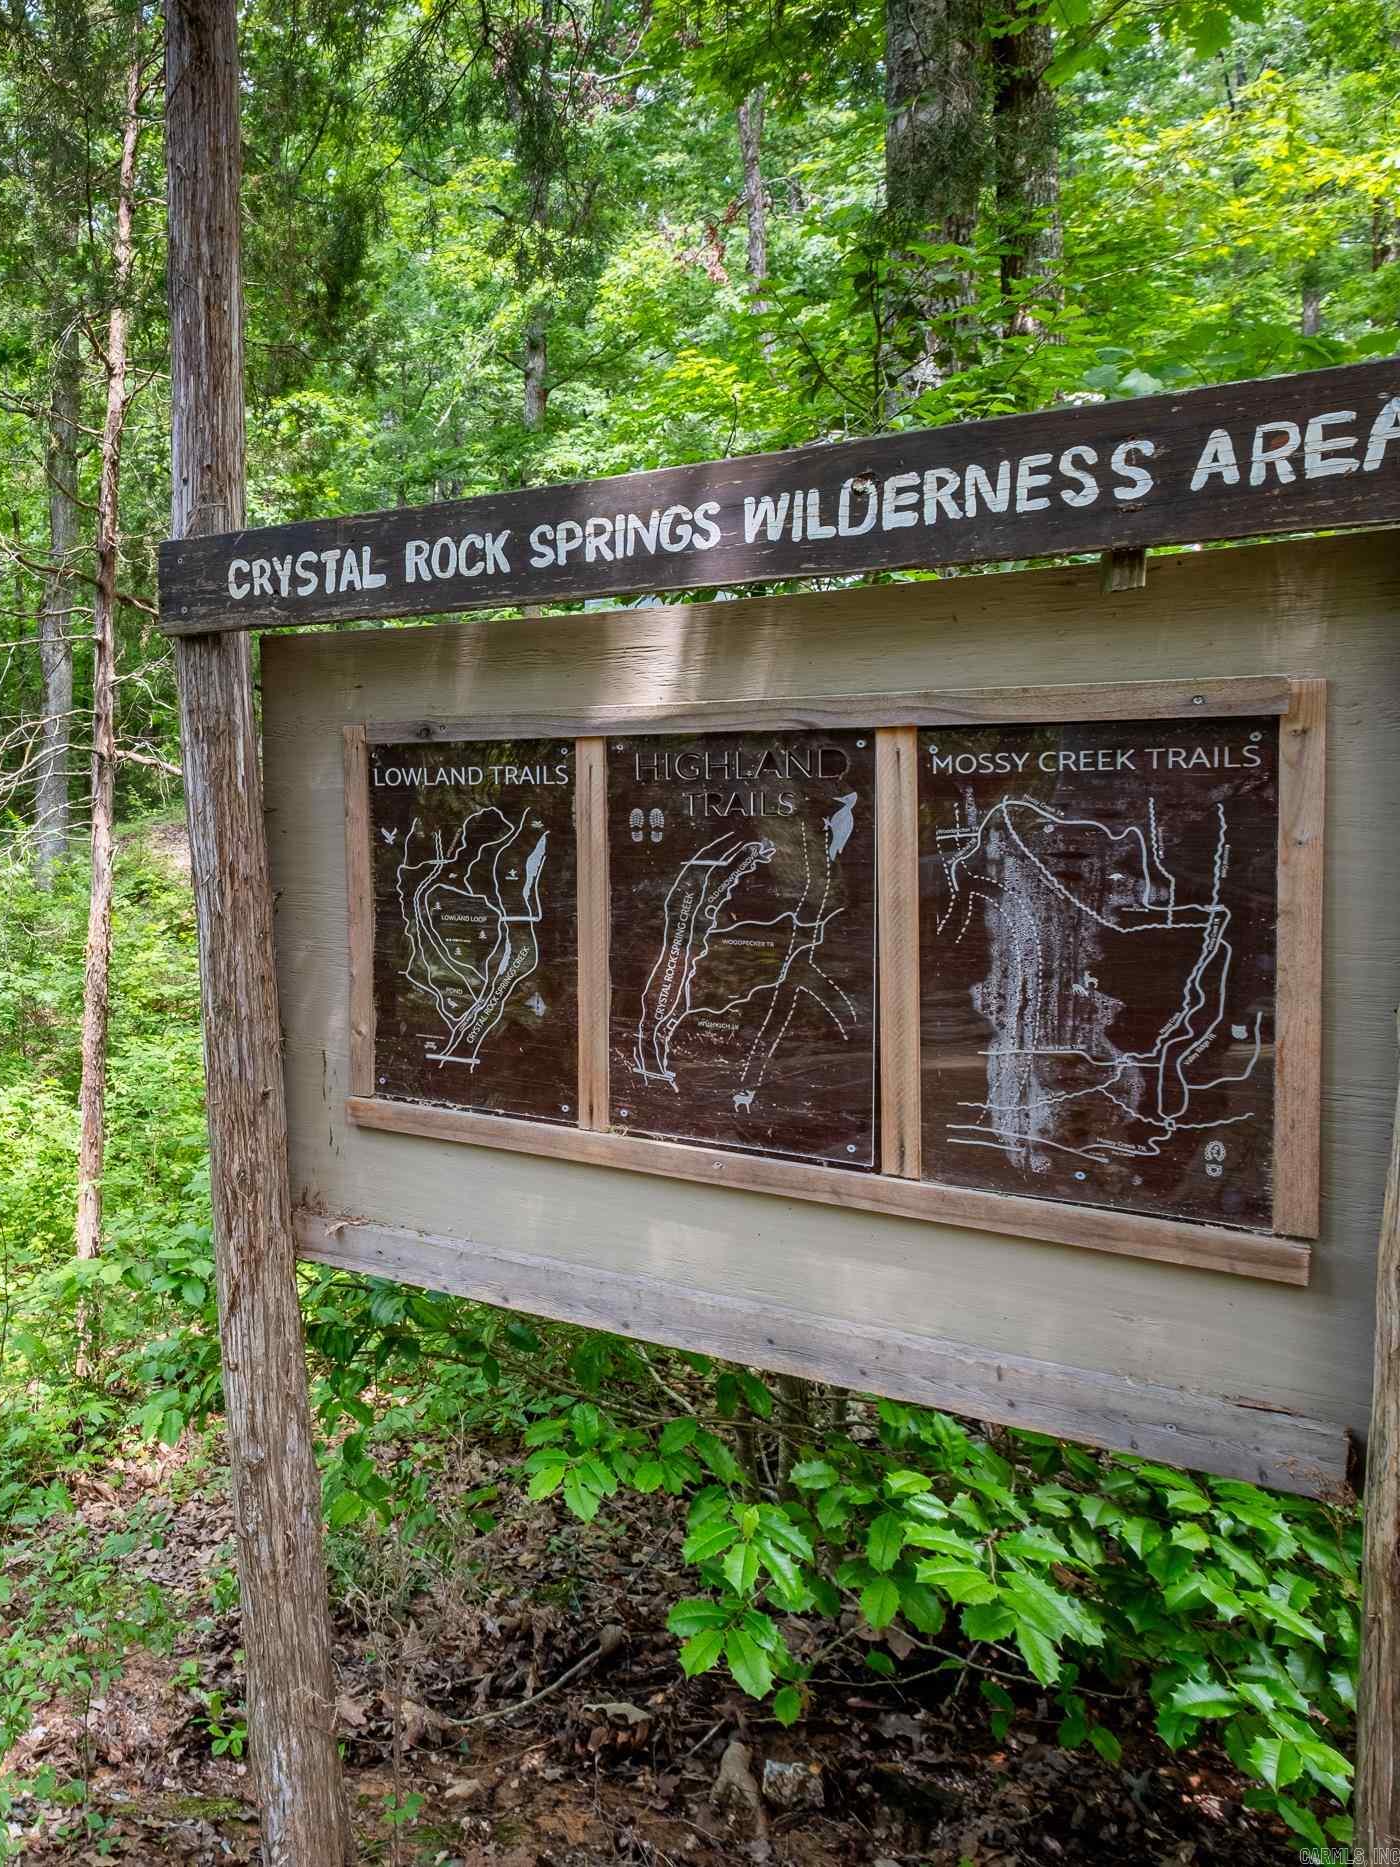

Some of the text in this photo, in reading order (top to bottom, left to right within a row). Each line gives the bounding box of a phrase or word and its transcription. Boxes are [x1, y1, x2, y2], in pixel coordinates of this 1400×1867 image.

[227, 396, 1400, 600] CRYSTAL ROCK SPRINGS WILDERNESS AREA
[374, 765, 569, 786] LOWLAND TRAILS
[635, 749, 849, 781] HIGHLAND
[932, 745, 1262, 775] MOSSY CREEK TRAILS
[683, 791, 796, 817] TRAILS
[655, 891, 694, 1020] CRYSTAL ROCK SPRING CREEK
[465, 1014, 487, 1044] CRYSTAL
[483, 995, 499, 1015] ROCK
[494, 967, 517, 997] SPRINGS
[511, 945, 530, 969] CREEK
